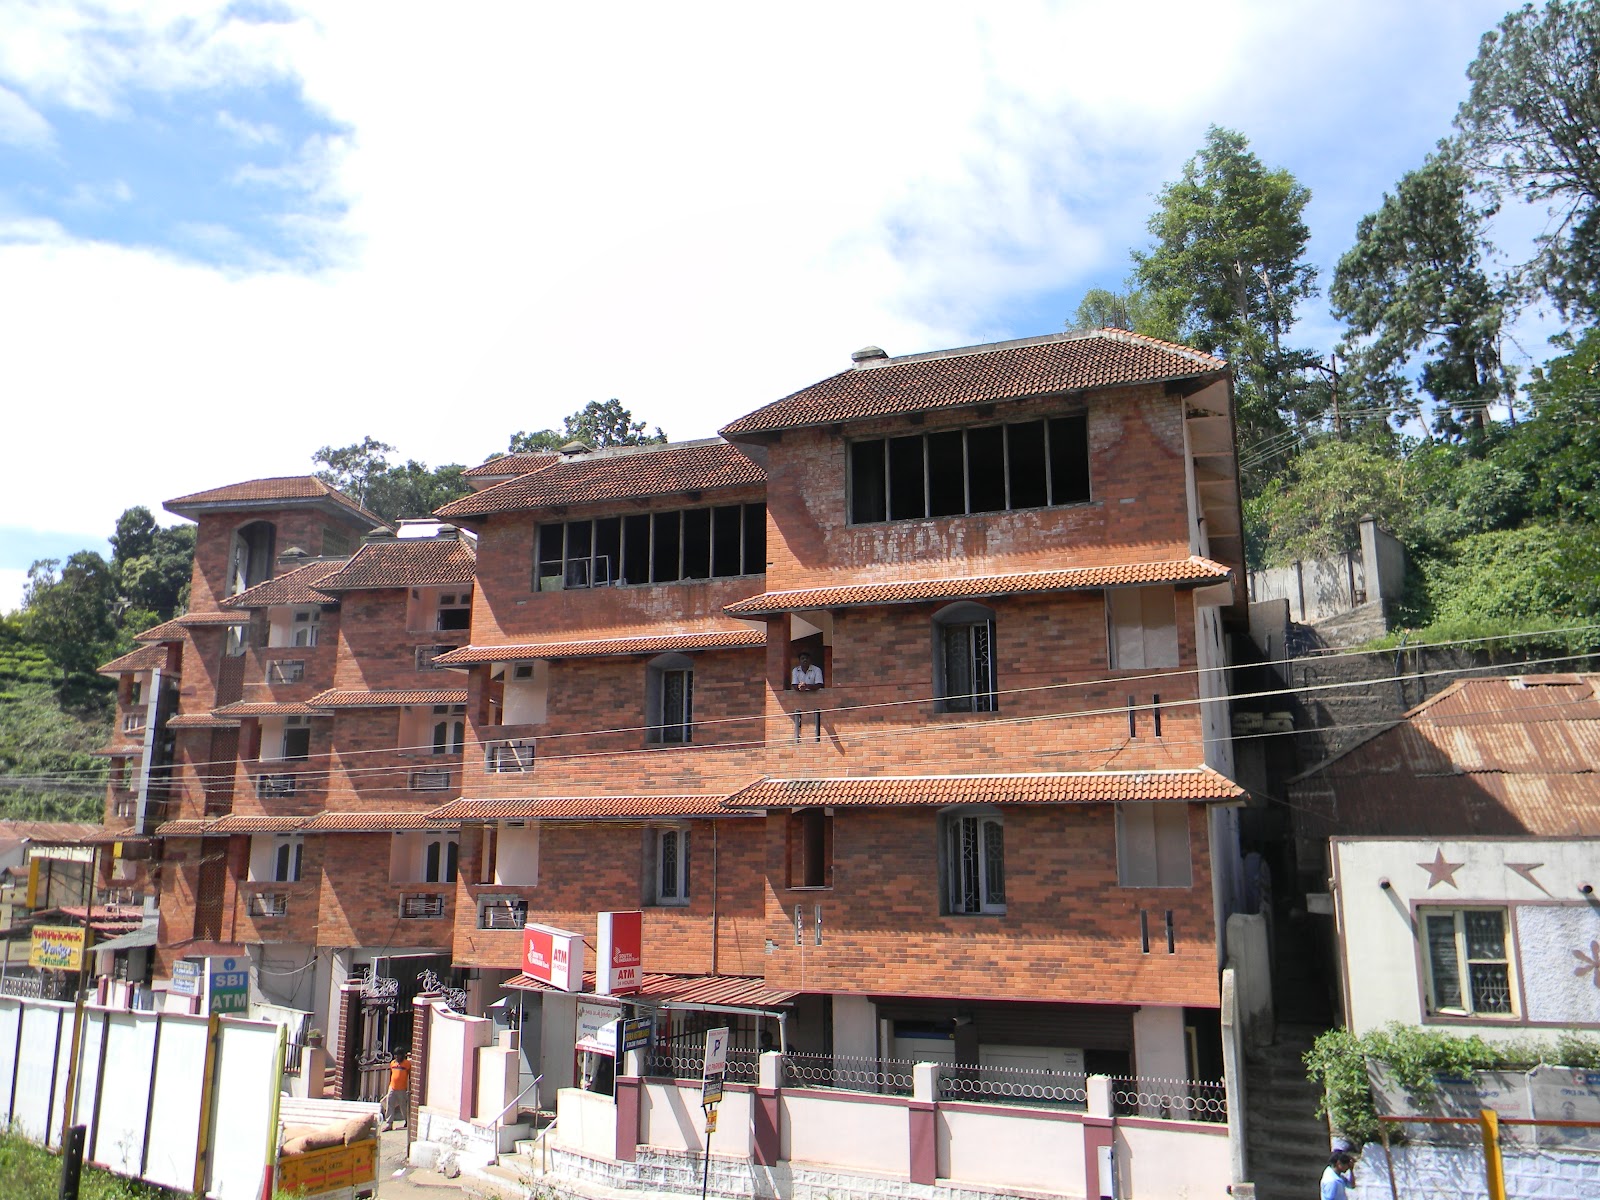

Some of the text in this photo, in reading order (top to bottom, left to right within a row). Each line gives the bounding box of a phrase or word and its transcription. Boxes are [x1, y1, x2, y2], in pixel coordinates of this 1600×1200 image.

[553, 948, 567, 964] ATM
[557, 965, 567, 973] HOURS
[618, 969, 635, 980] ATM
[215, 974, 244, 987] SBI
[211, 993, 247, 1009] ATM
